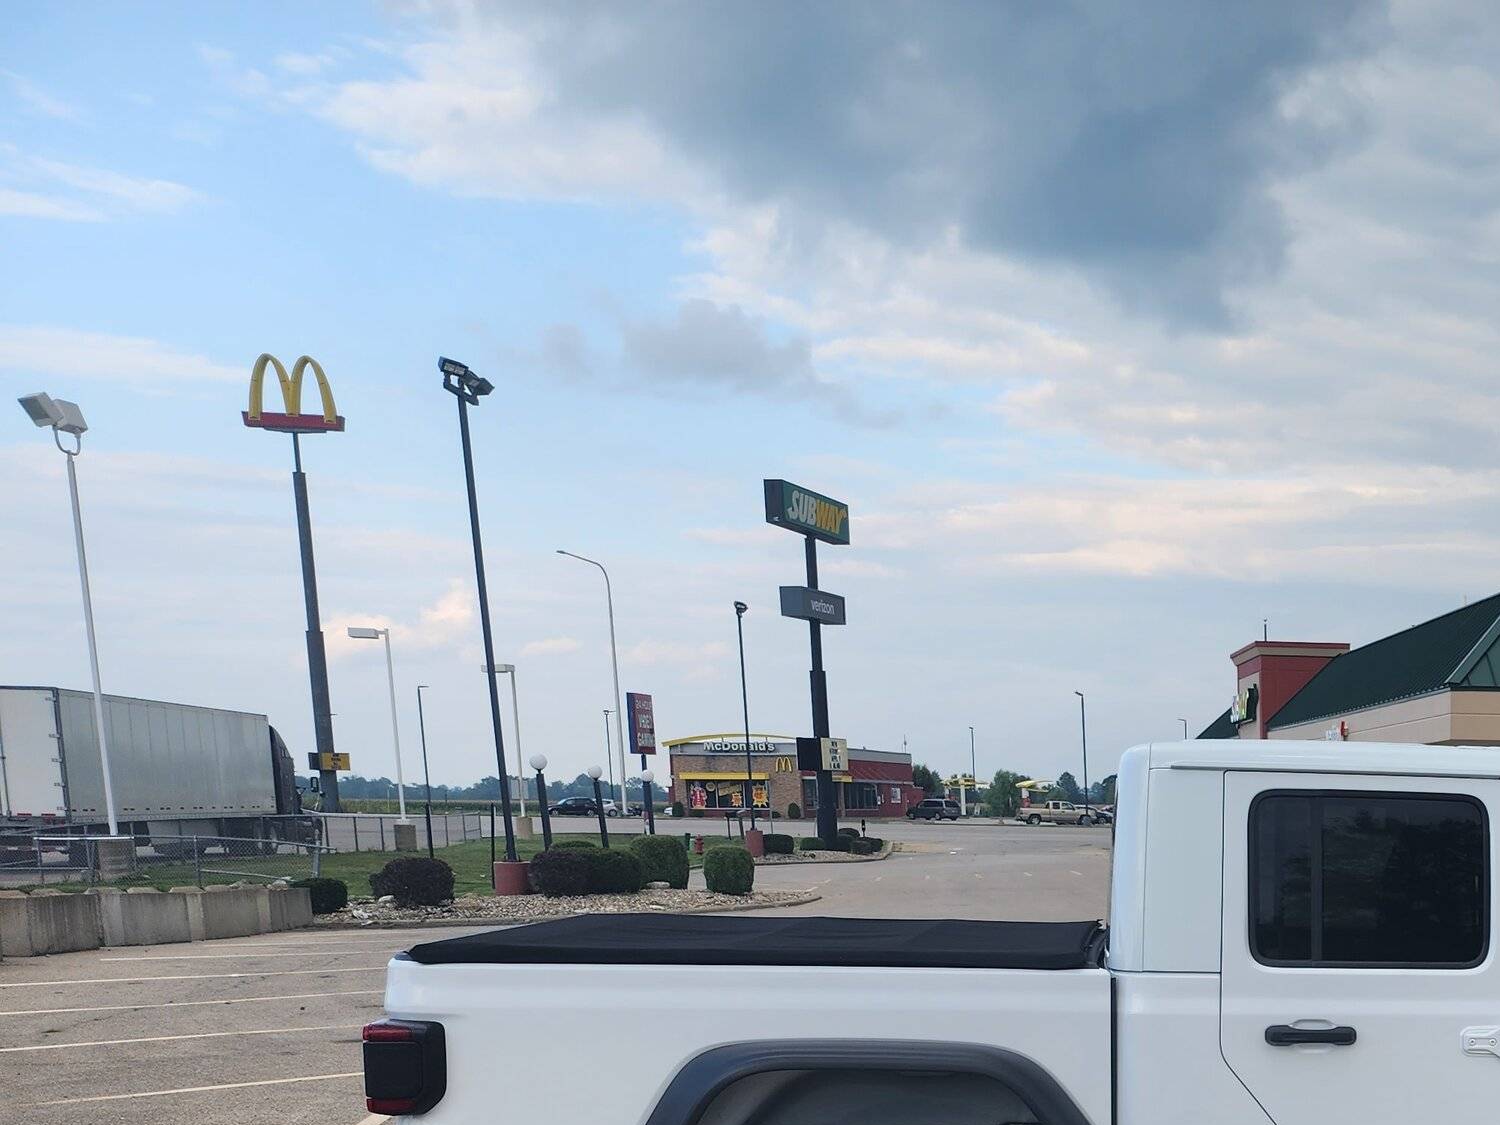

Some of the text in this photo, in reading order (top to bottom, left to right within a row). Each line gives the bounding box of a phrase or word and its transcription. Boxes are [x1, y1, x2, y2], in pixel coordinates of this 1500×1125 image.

[787, 490, 847, 534] SUBWAY
[810, 599, 835, 615] verizon
[703, 741, 775, 752] McDonald's
